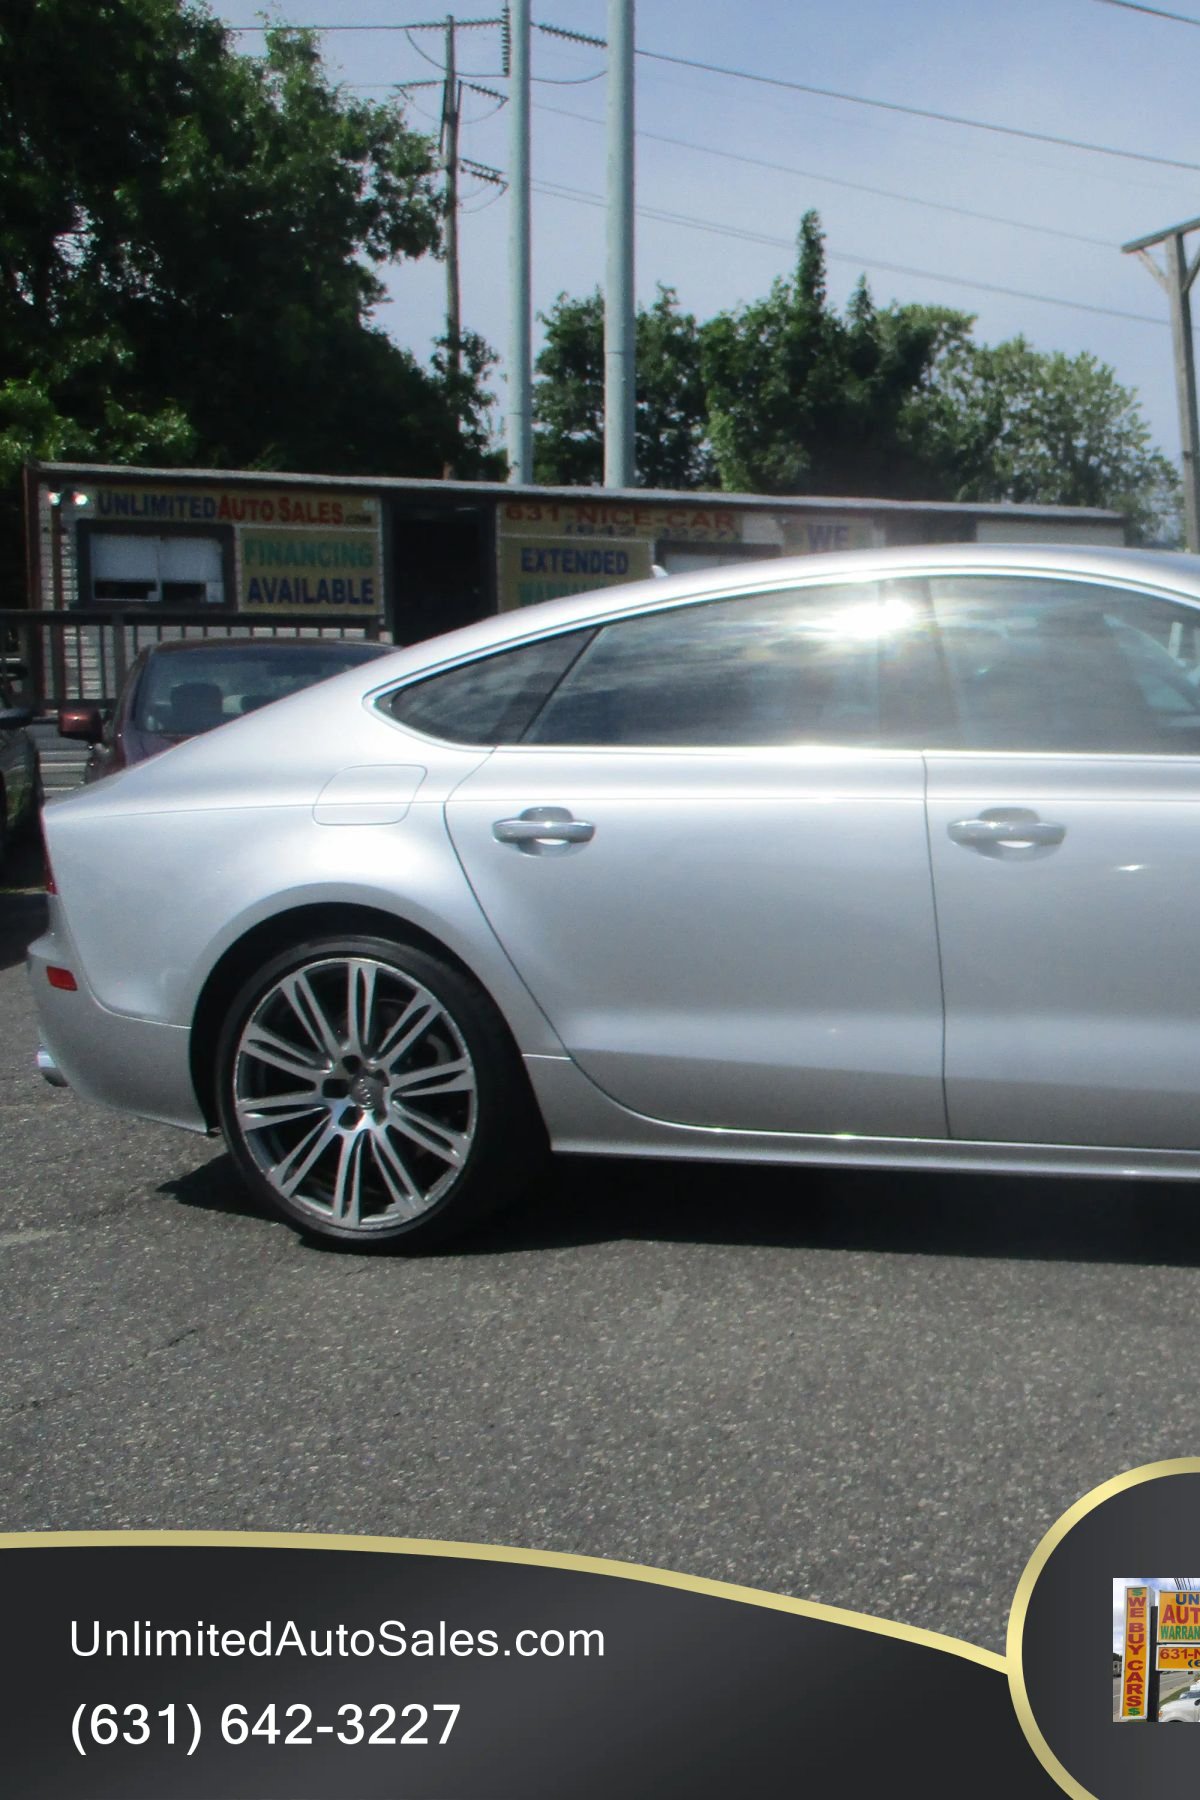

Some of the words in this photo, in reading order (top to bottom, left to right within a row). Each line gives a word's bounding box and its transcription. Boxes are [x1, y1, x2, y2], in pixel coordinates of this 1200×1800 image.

[244, 538, 373, 568] FINANCING
[520, 547, 630, 576] EXTENDED
[249, 576, 374, 605] AVAILABLE
